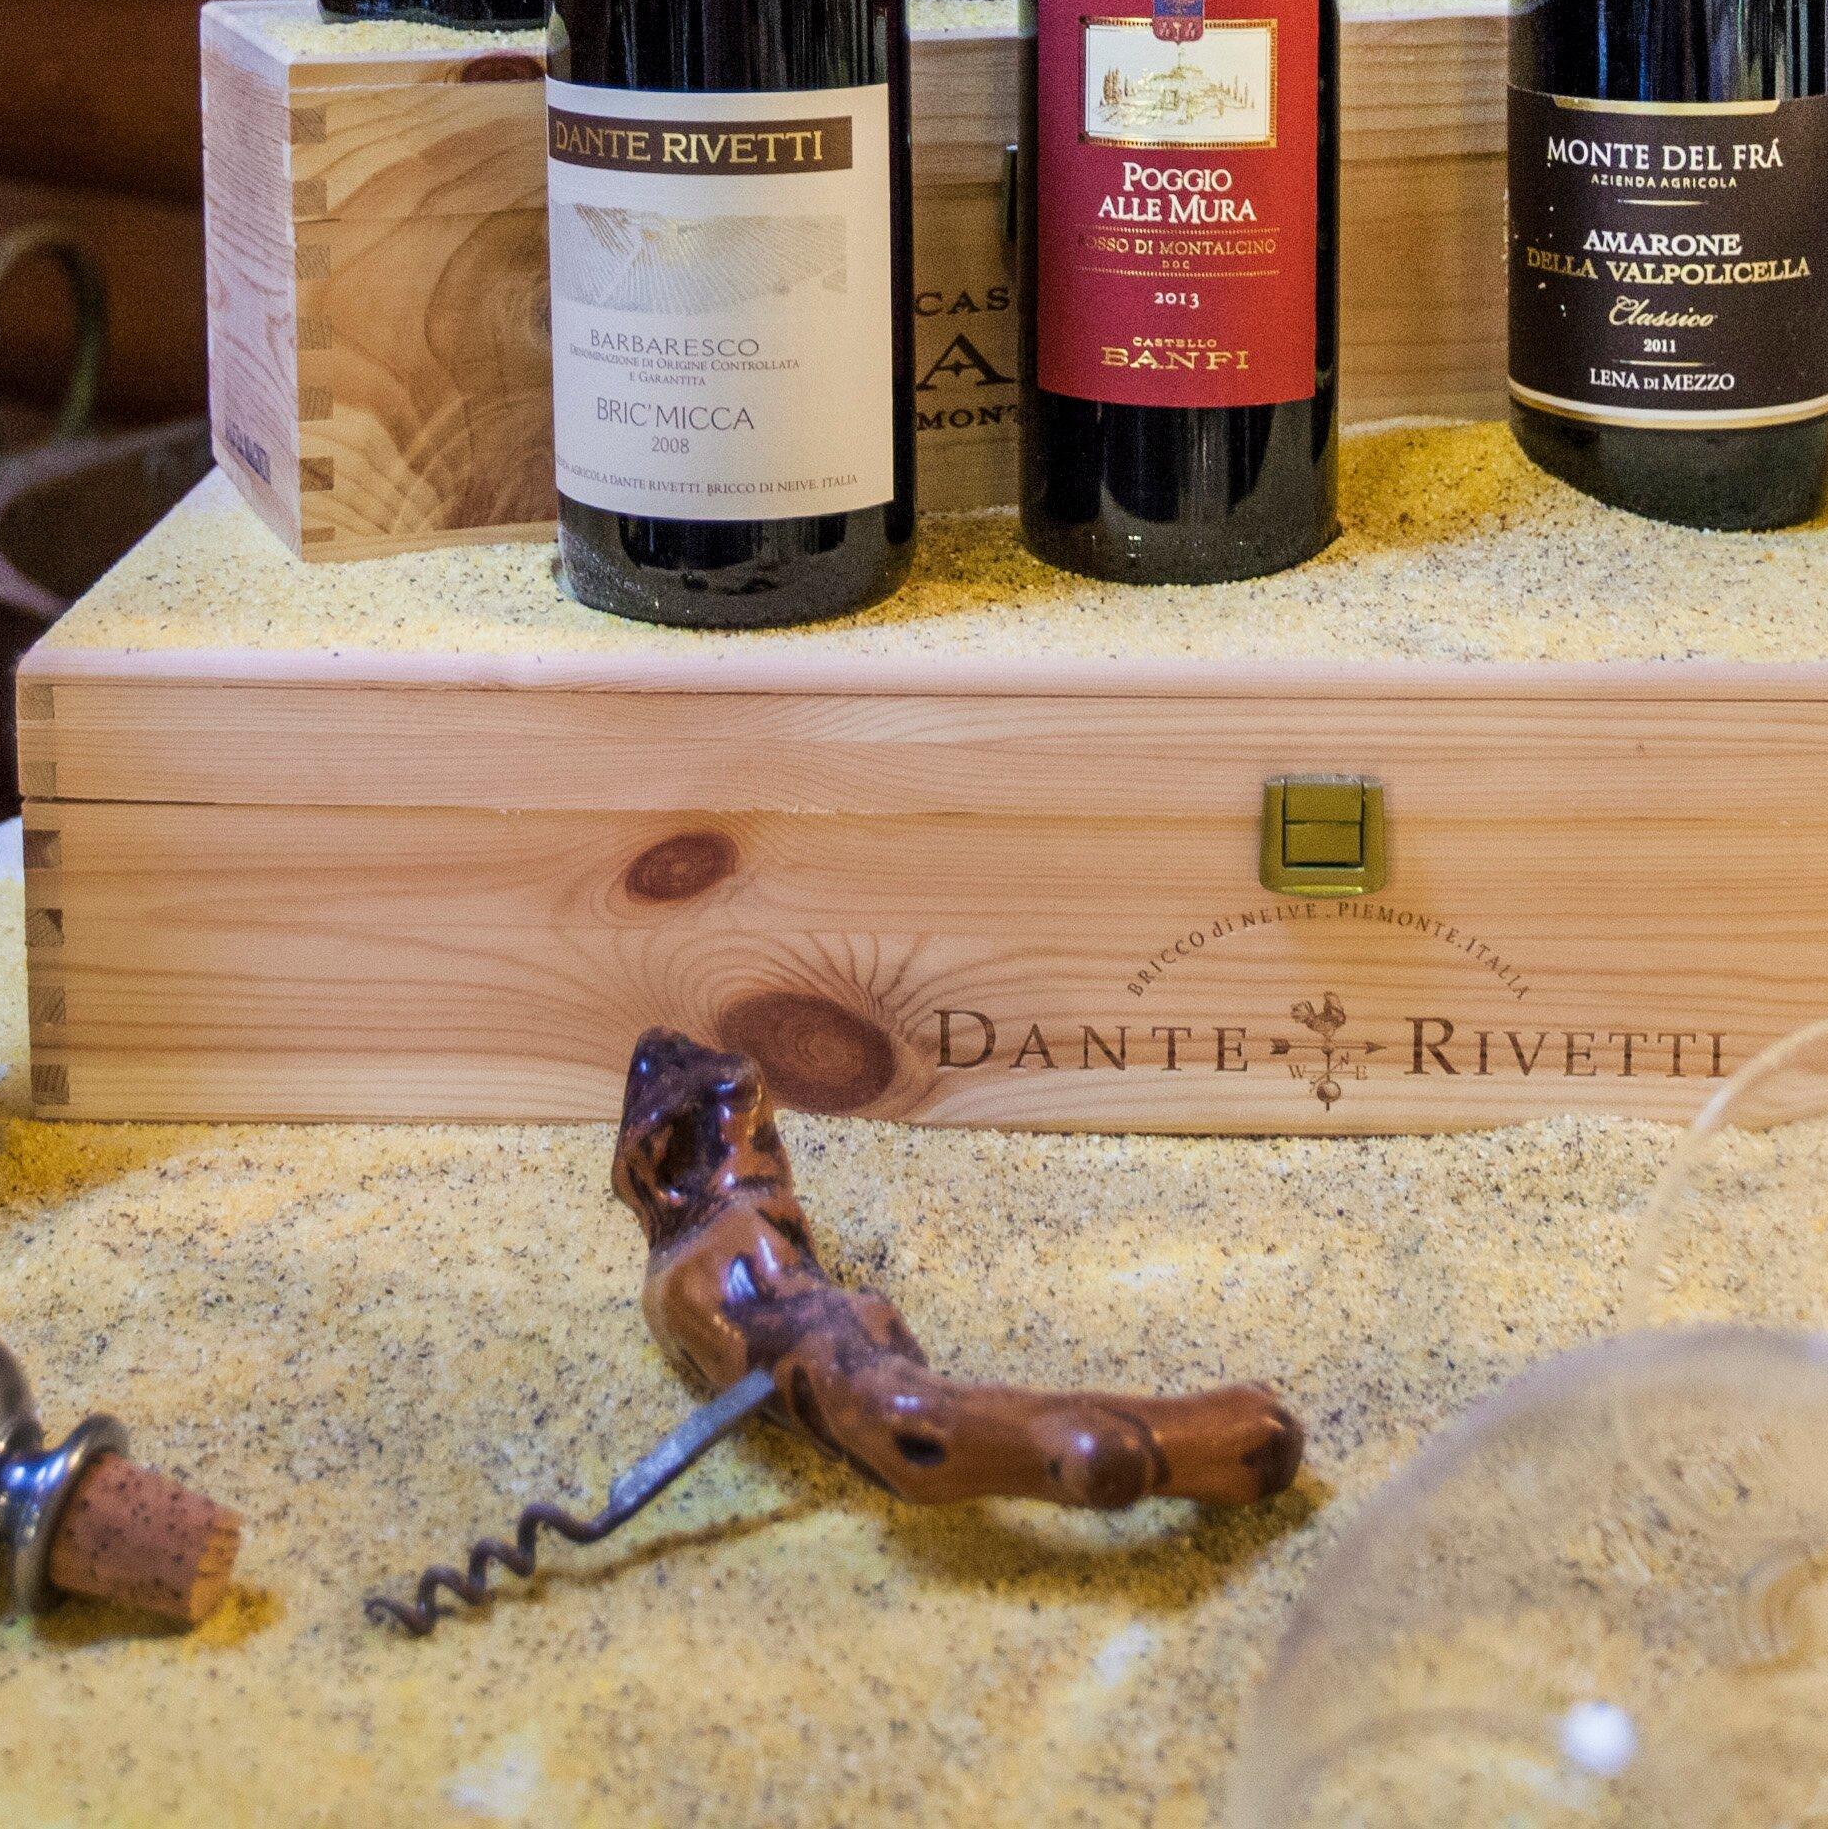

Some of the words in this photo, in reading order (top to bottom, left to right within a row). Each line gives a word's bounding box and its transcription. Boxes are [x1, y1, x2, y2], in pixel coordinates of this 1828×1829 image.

[555, 121, 651, 163] DANTE
[662, 131, 823, 165] RIVETTI
[1547, 136, 1650, 170] MONTE
[1662, 145, 1722, 171] DEL
[1122, 162, 1233, 193] POGGIO
[1591, 174, 1656, 188] AZIENDA
[1660, 176, 1737, 190] AGRICOLA
[1097, 194, 1162, 222] ALLE
[1168, 194, 1257, 225] MURA
[1135, 238, 1153, 255] DI
[1159, 238, 1277, 256] MONTALCINO
[1583, 229, 1743, 257] AMARONE
[1162, 260, 1190, 270] DOC
[1527, 247, 1598, 279] DELLA
[1606, 256, 1812, 285] VALPOLICELLA
[915, 286, 1011, 316] CAS
[1153, 291, 1200, 308] 2013
[1609, 296, 1714, 328] Classico
[590, 329, 759, 357] BARBARESCO
[1132, 336, 1217, 348] CASTELLO
[1643, 339, 1677, 354] 2011
[642, 358, 653, 367] DI
[656, 358, 707, 371] ORIGINE
[711, 359, 800, 372] CONTROLLATA
[1100, 347, 1249, 371] BANFI
[638, 371, 706, 386] GARANTITA
[1590, 368, 1639, 390] LENA
[1644, 376, 1659, 390] DI
[1661, 373, 1736, 392] MEZZO
[651, 436, 690, 454] 2008
[610, 474, 646, 490] DANTE
[707, 483, 756, 494] BRICCO
[760, 482, 773, 493] DI
[822, 474, 858, 488] ITALIA
[1127, 931, 1205, 997] BRICCO
[1212, 918, 1234, 938] di
[934, 1009, 1249, 1072] DANTE
[1403, 1016, 1728, 1079] RIVETTI
